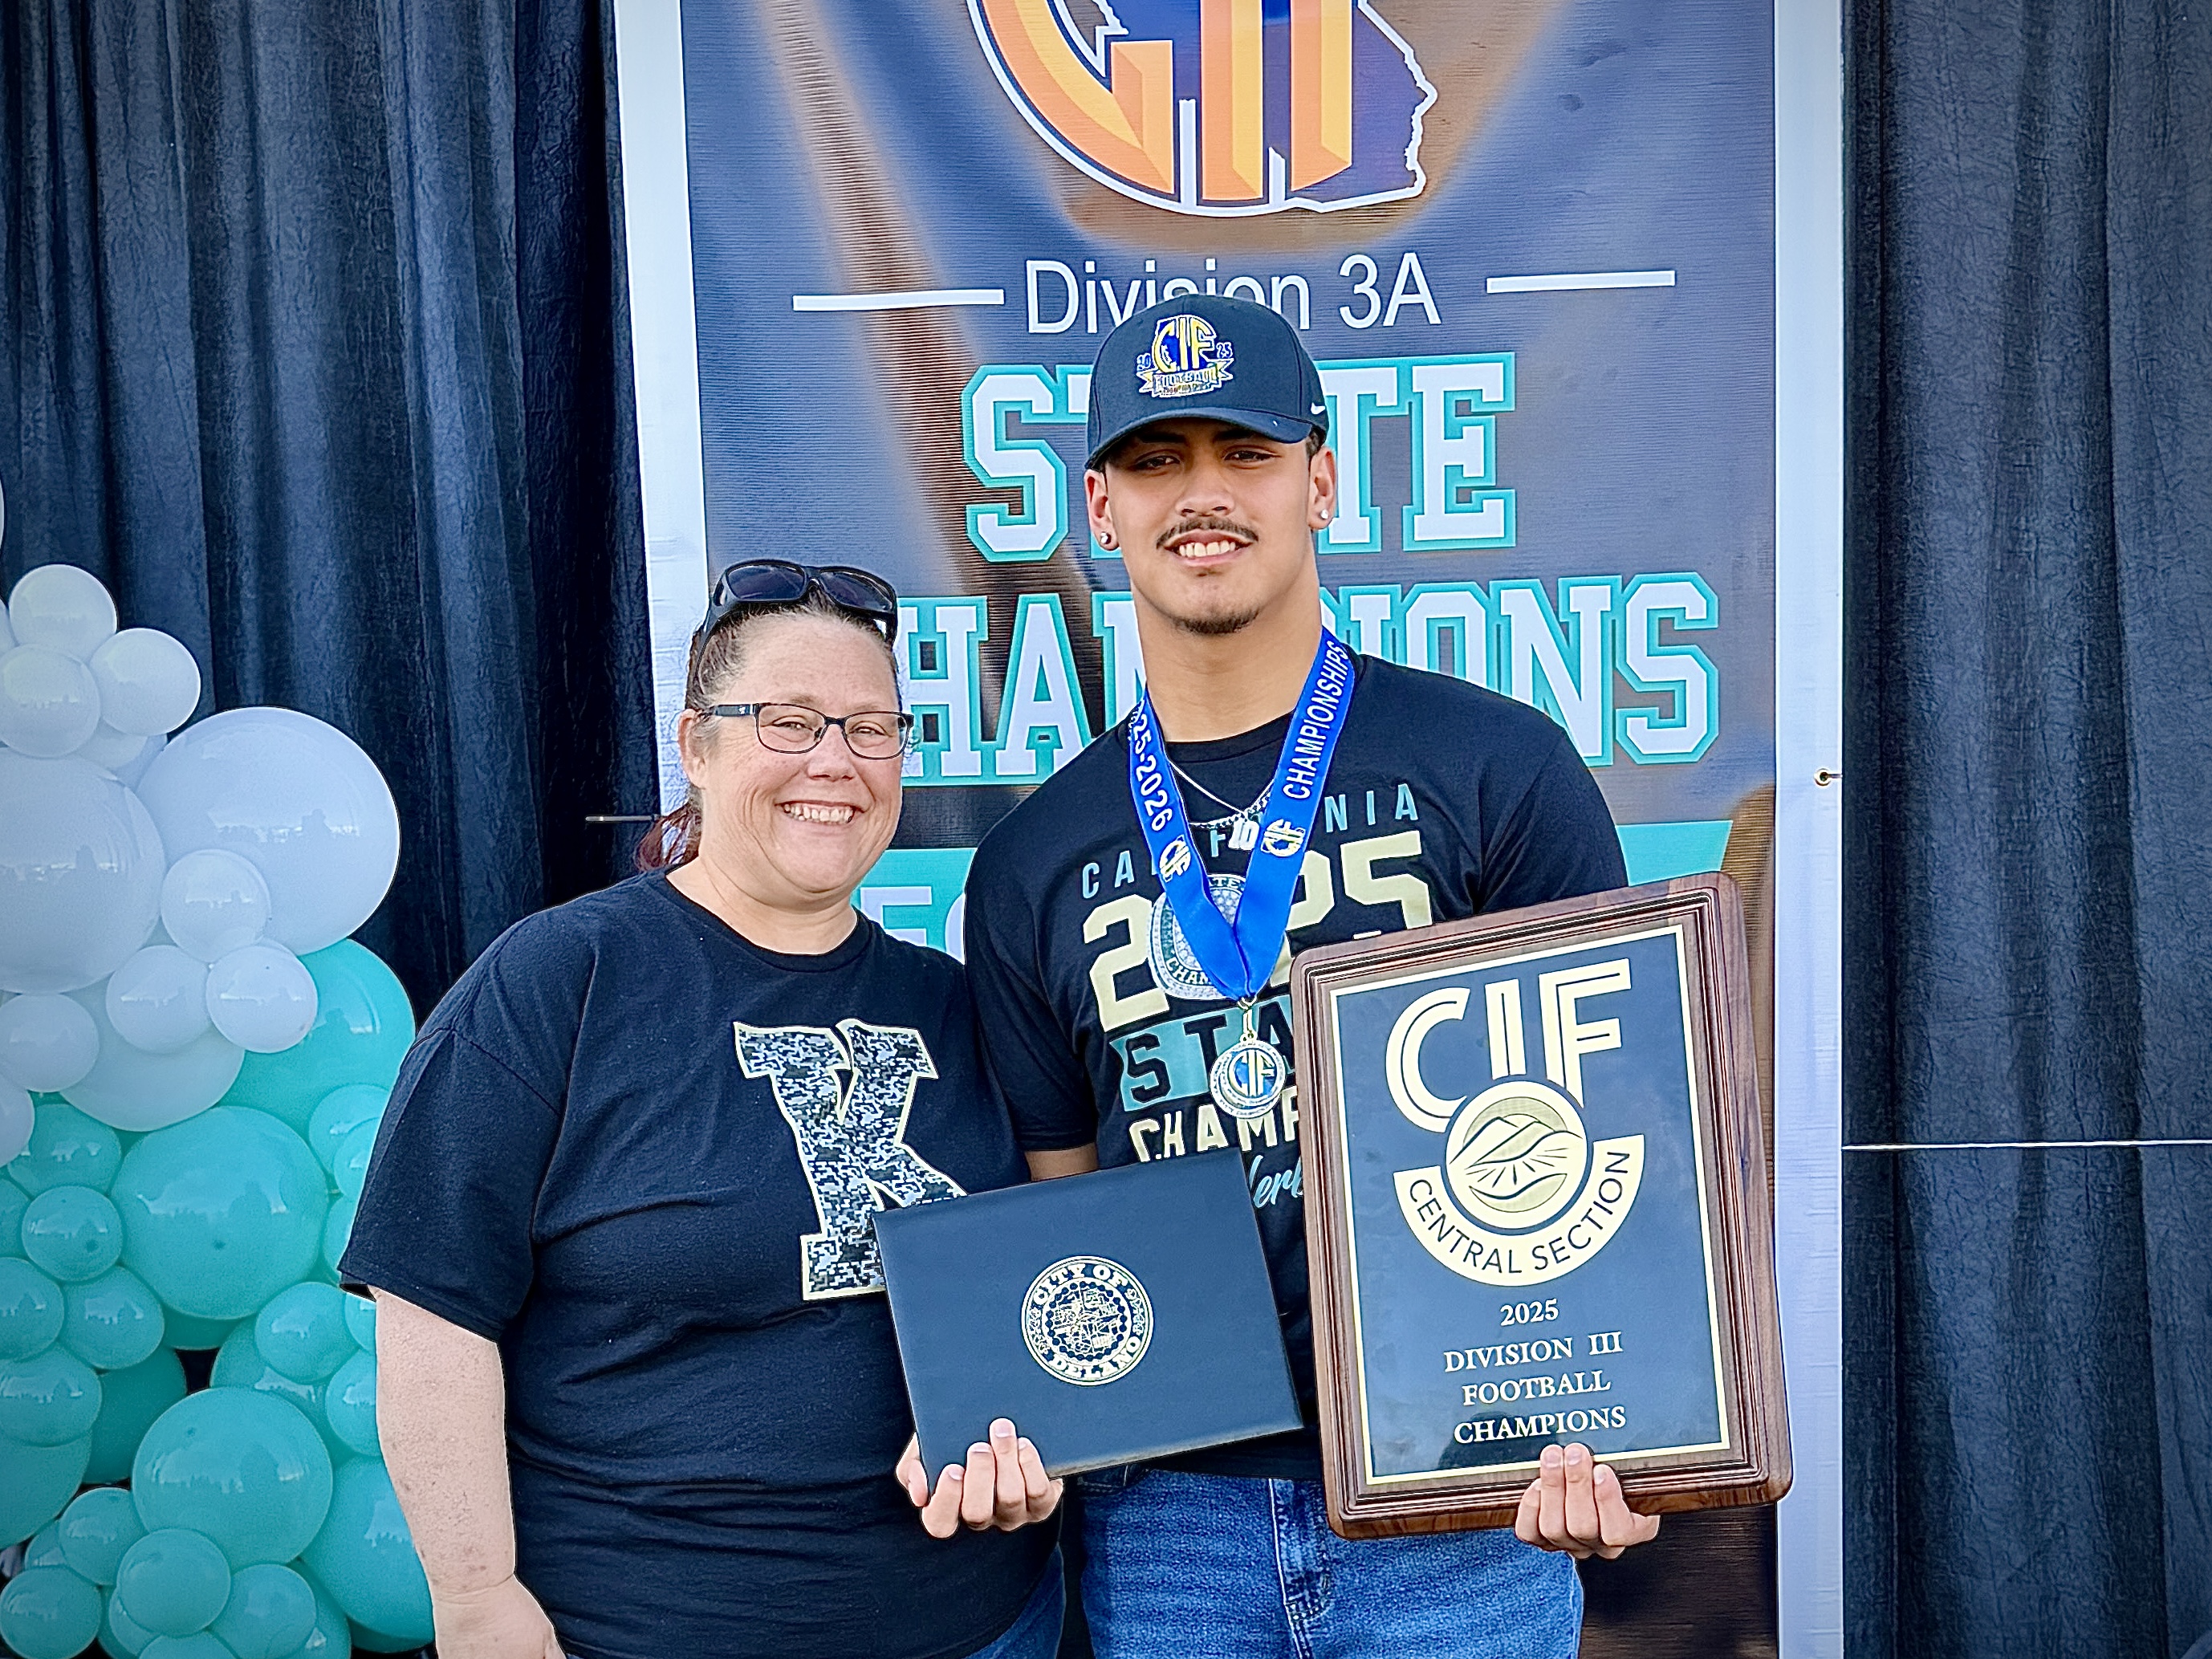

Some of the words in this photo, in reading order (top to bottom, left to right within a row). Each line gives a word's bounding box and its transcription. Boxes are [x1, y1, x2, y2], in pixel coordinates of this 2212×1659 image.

[1338, 252, 1442, 329] 3A
[1153, 316, 1214, 373] CIF
[966, 352, 1516, 563] STE
[1283, 640, 1350, 799] CHAMPIONSHIPS
[1128, 700, 1173, 832] 25-2026
[1227, 1049, 1277, 1098] CIF
[1385, 958, 1632, 1134] CIF
[733, 1018, 968, 1301] K
[1409, 1179, 1523, 1275] CENTRAL
[1531, 1151, 1631, 1271] SECTION
[1032, 1263, 1087, 1306] CITY
[1092, 1264, 1128, 1290] OF
[1499, 1298, 1559, 1327] 2025
[1051, 1336, 1141, 1380] DELANO
[1443, 1336, 1573, 1373] DIVISION
[1588, 1331, 1623, 1356] III
[1462, 1370, 1612, 1406] FOOTBALL
[1453, 1405, 1628, 1446] CHAMPIONS
